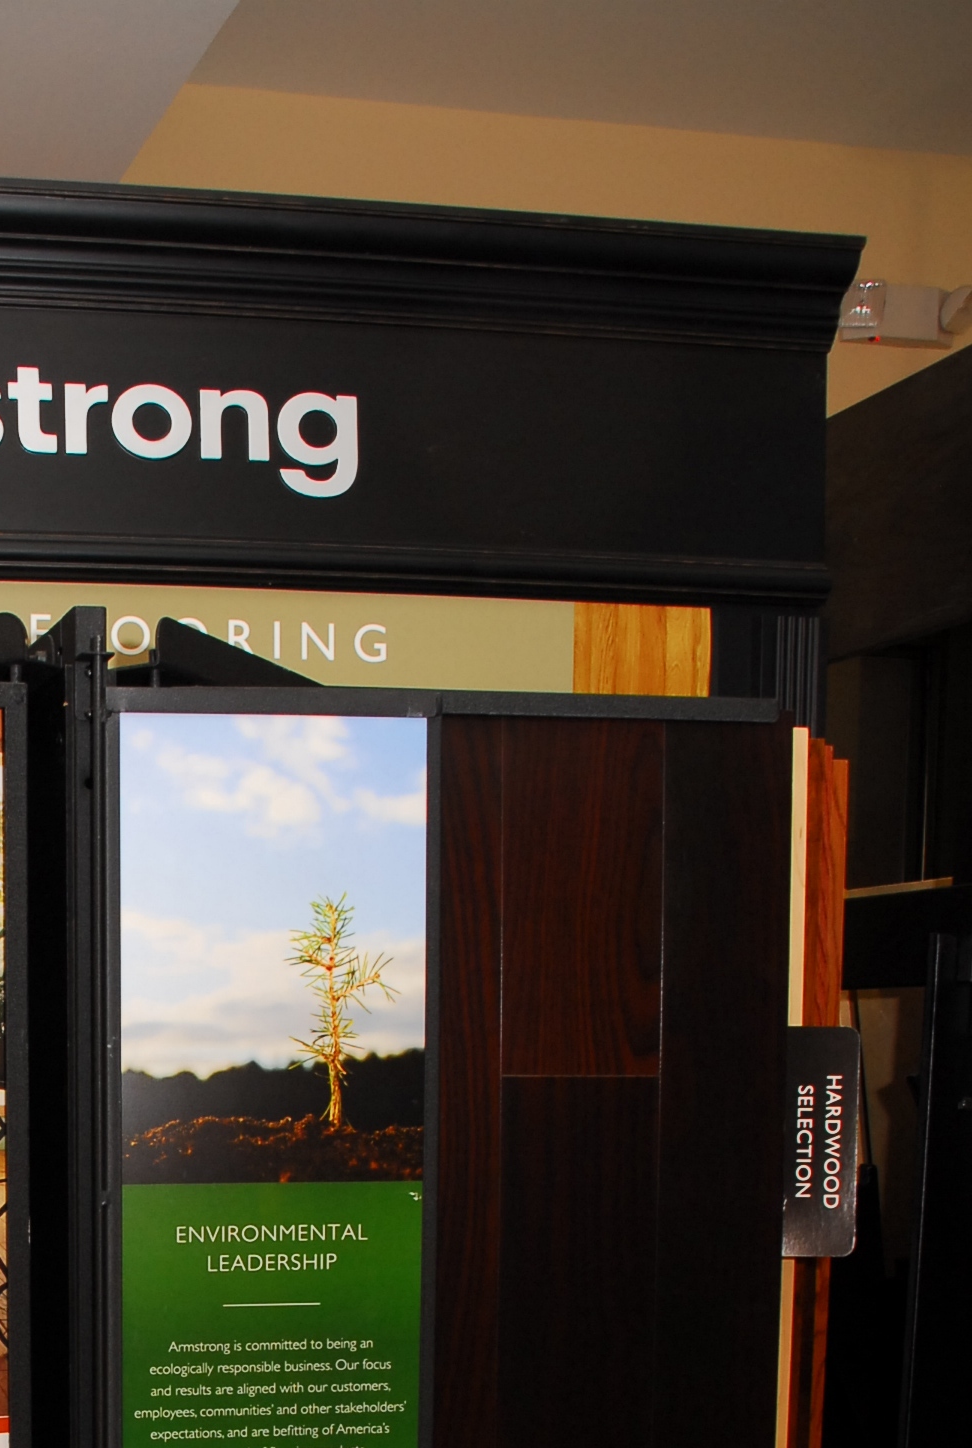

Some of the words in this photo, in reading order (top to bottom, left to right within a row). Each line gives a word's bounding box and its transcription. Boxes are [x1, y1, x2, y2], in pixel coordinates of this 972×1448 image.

[30, 614, 389, 665] FORING
[795, 1085, 814, 1198] SELECTION
[823, 1075, 843, 1209] HARDWOOD
[177, 1224, 368, 1243] ENVIRONMENTAL
[208, 1253, 337, 1272] LEADERSHIP
[168, 1341, 230, 1354] Armstrong
[234, 1340, 242, 1351] is
[246, 1339, 307, 1351] committed
[310, 1340, 323, 1349] to
[327, 1338, 357, 1352] being
[360, 1340, 373, 1348] an
[150, 1363, 214, 1377] ecologically
[218, 1361, 281, 1376] responsible
[285, 1360, 332, 1372] business.
[335, 1359, 359, 1370] Our
[363, 1359, 391, 1370] focus
[151, 1385, 171, 1396] and
[176, 1385, 211, 1396] results
[215, 1387, 233, 1395] are
[237, 1383, 276, 1397] aligned
[280, 1382, 304, 1393] with
[308, 1384, 328, 1392] our
[331, 1382, 391, 1392] customers,
[134, 1407, 197, 1421] employees,
[276, 1404, 297, 1415] and
[301, 1403, 332, 1414] other
[150, 1428, 224, 1442] expectations,
[227, 1426, 247, 1437] and
[252, 1429, 269, 1437] are
[273, 1425, 318, 1438] befitting
[322, 1424, 334, 1435] of
